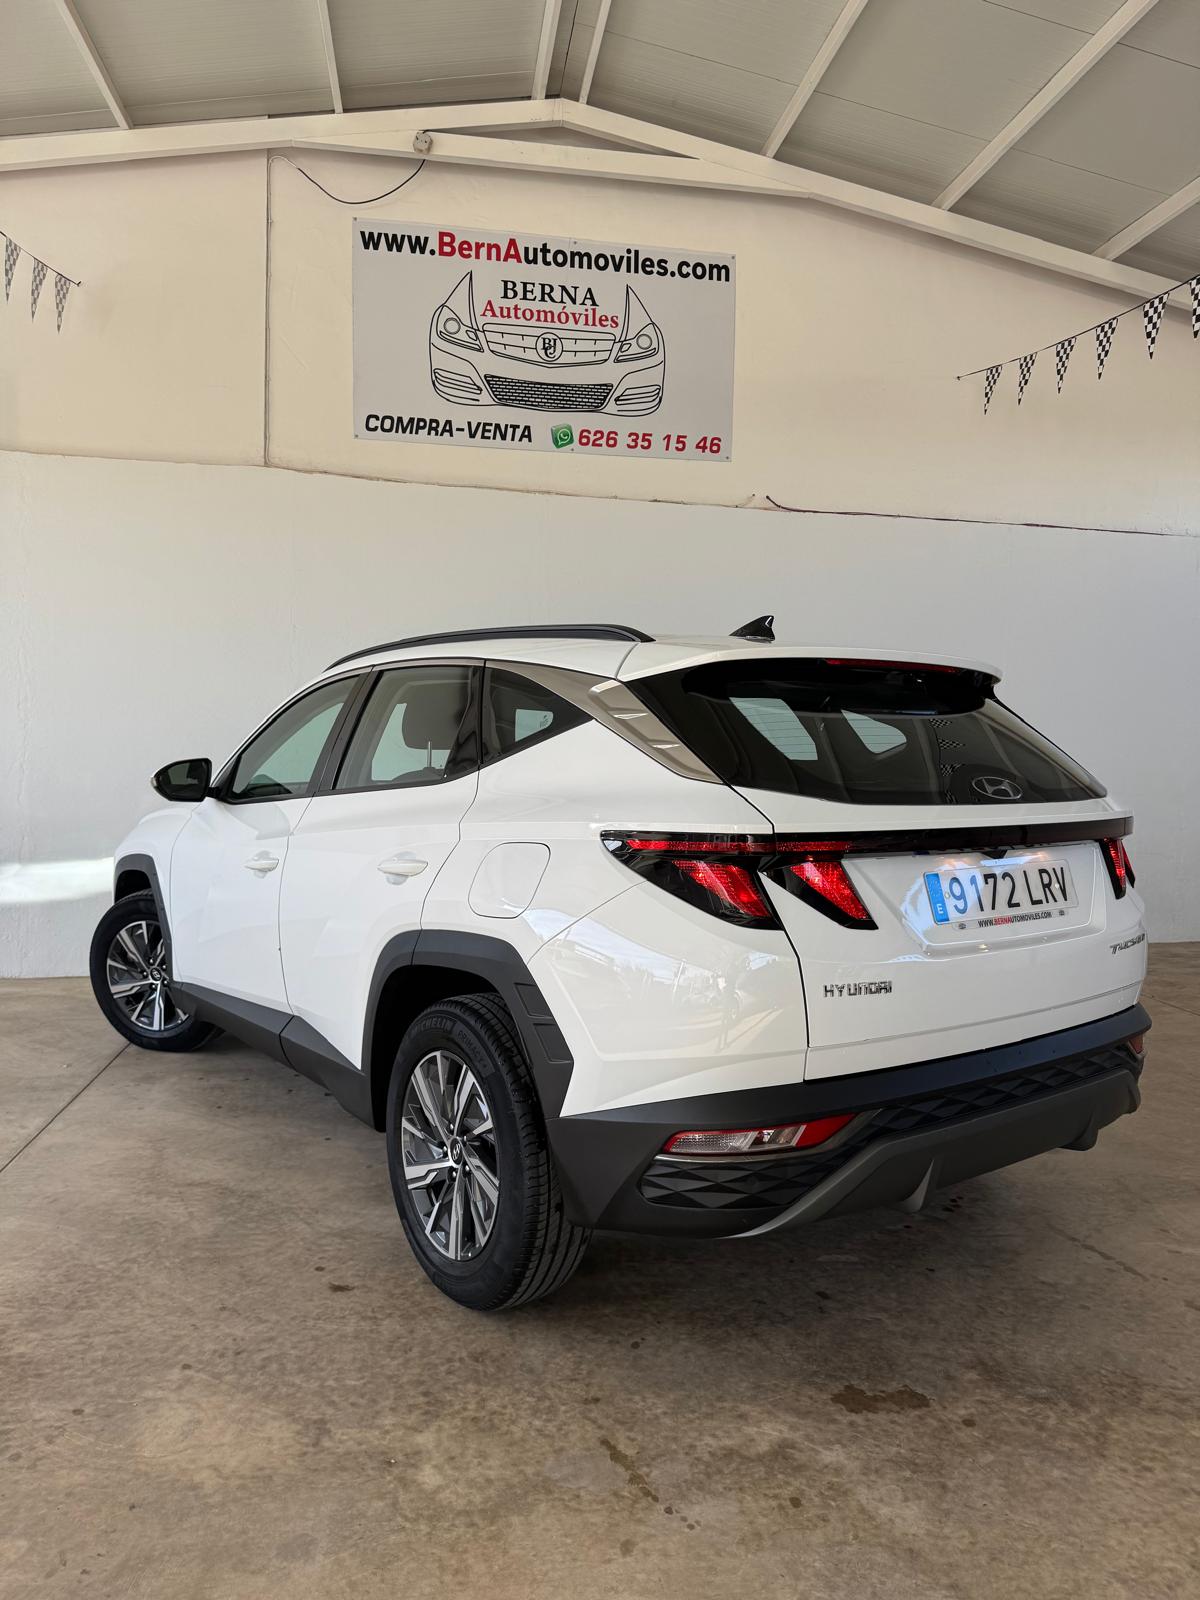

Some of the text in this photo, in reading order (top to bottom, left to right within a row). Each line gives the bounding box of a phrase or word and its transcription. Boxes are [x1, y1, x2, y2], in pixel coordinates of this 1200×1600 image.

[360, 230, 730, 282] www.BernAutomoviles.com
[500, 279, 599, 307] BERNA
[480, 299, 619, 329] Automóviles
[365, 414, 533, 443] COMPRA-VENTA
[578, 428, 722, 454] 626 35 15 46
[949, 866, 1068, 914] 9172 LRV
[937, 903, 944, 914] E
[978, 911, 1052, 928] WWW.BERNAUTOMOVILES.COM
[823, 981, 892, 998] HYUNDAI
